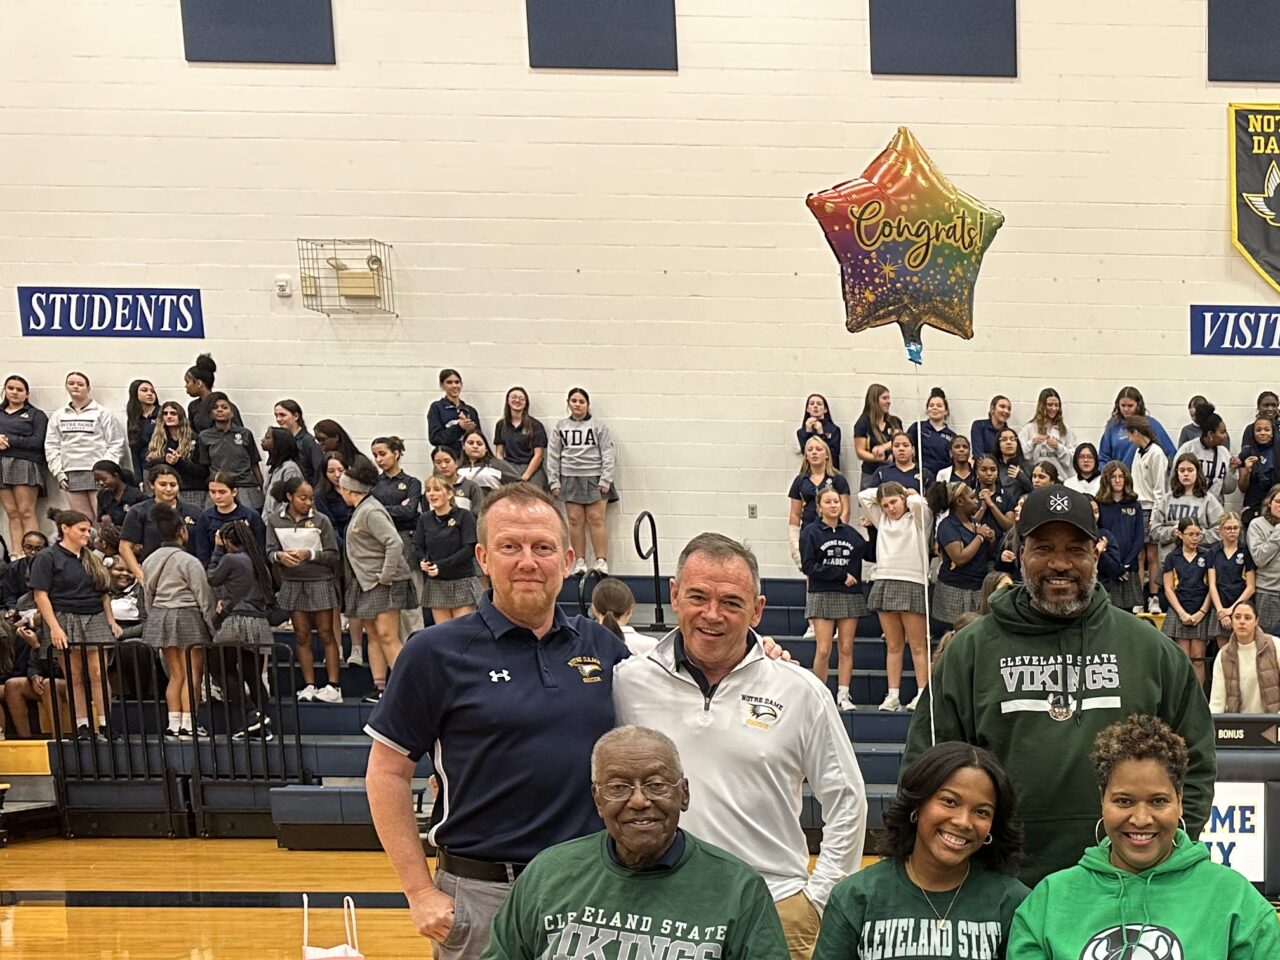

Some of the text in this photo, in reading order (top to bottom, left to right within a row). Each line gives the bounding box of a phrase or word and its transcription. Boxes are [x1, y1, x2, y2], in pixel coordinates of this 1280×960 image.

[850, 200, 986, 269] Congrats!
[29, 292, 194, 332] STUDENTS
[559, 428, 597, 446] NDA
[1199, 459, 1227, 479] DA
[1167, 503, 1200, 522] NDA
[1000, 653, 1117, 667] CLEVELAND STATE
[1000, 663, 1120, 693] VIKINGS
[741, 694, 784, 711] NOTRE DAME
[1218, 728, 1244, 739] BONUS
[1207, 806, 1255, 833] ME
[544, 906, 727, 941] CLEELAND STATE
[957, 920, 1002, 960] STAT
